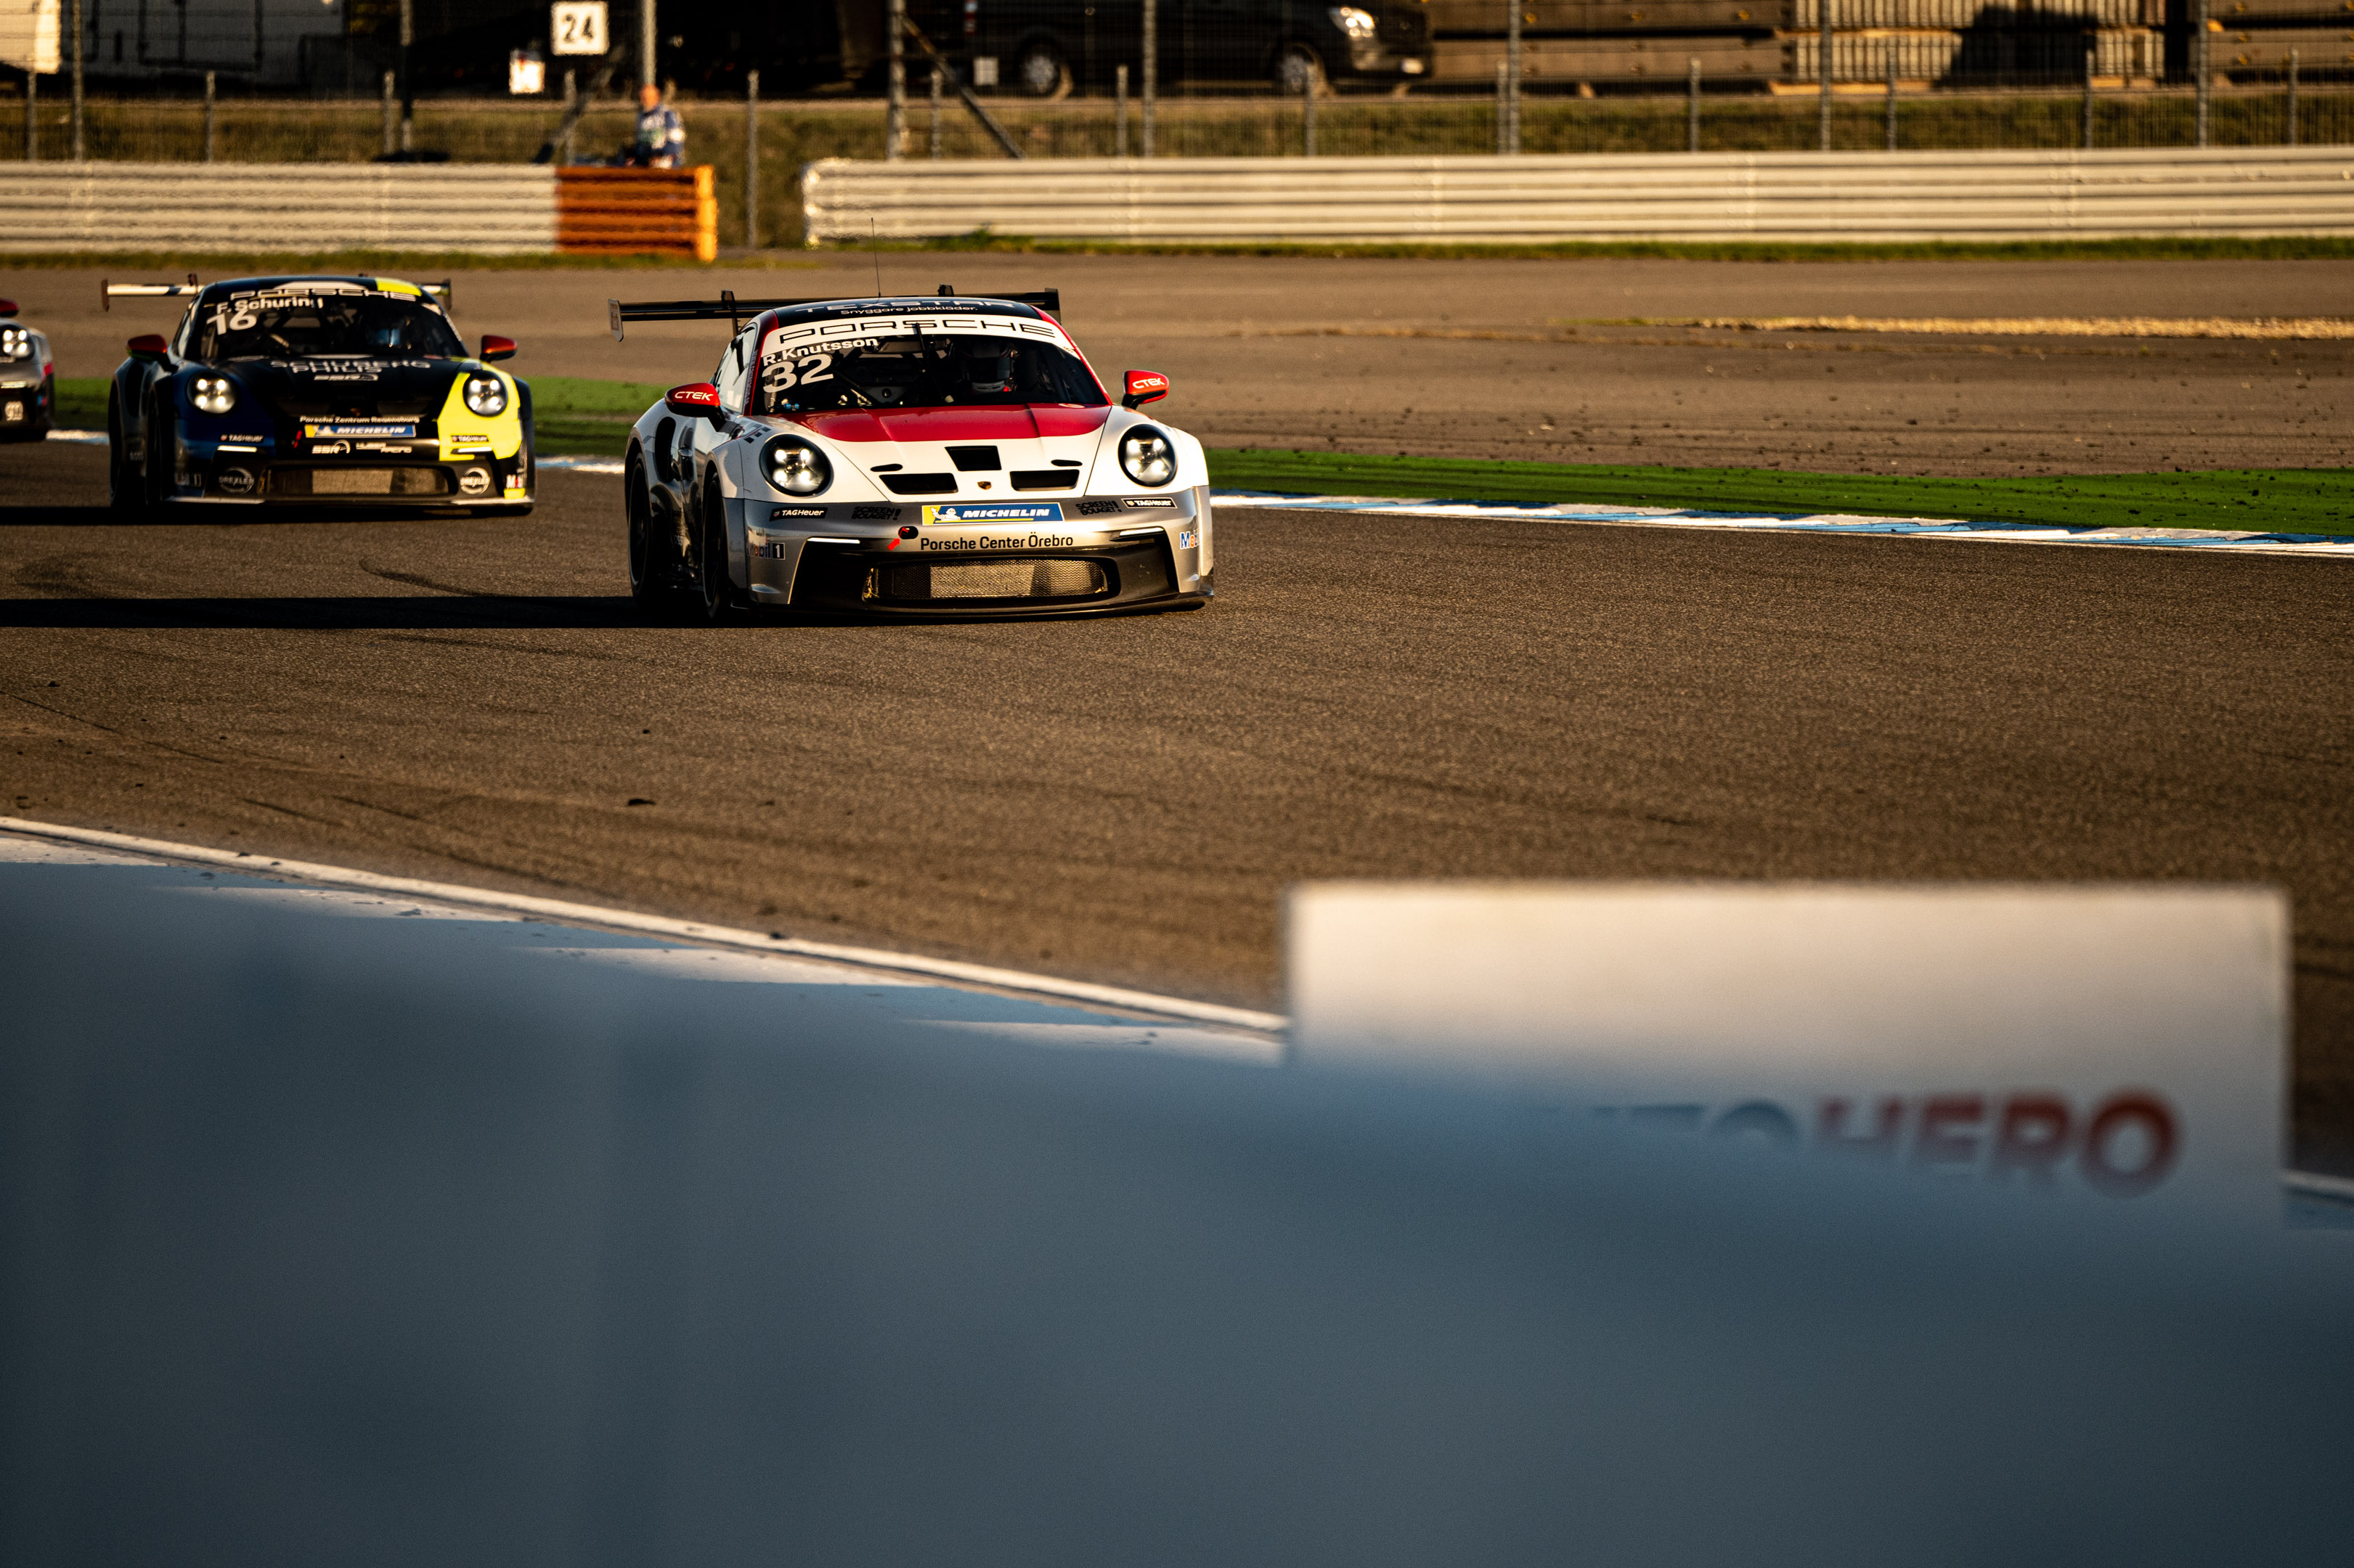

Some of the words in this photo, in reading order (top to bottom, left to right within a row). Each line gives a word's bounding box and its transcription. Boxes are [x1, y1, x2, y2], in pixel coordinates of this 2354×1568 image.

[563, 14, 593, 43] 24
[230, 288, 416, 302] PORSCHE
[217, 301, 232, 314] F.
[795, 300, 1017, 313] TEXSTAR
[206, 309, 257, 335] 16
[779, 319, 1056, 344] PORSCHE
[761, 353, 834, 393] 32
[1132, 377, 1166, 389] CTEK
[675, 391, 714, 401] CTEK
[962, 509, 1050, 518] MICHELIN
[921, 537, 976, 550] Porsche
[980, 536, 1025, 549] Center
[1028, 531, 1073, 547] Örebro
